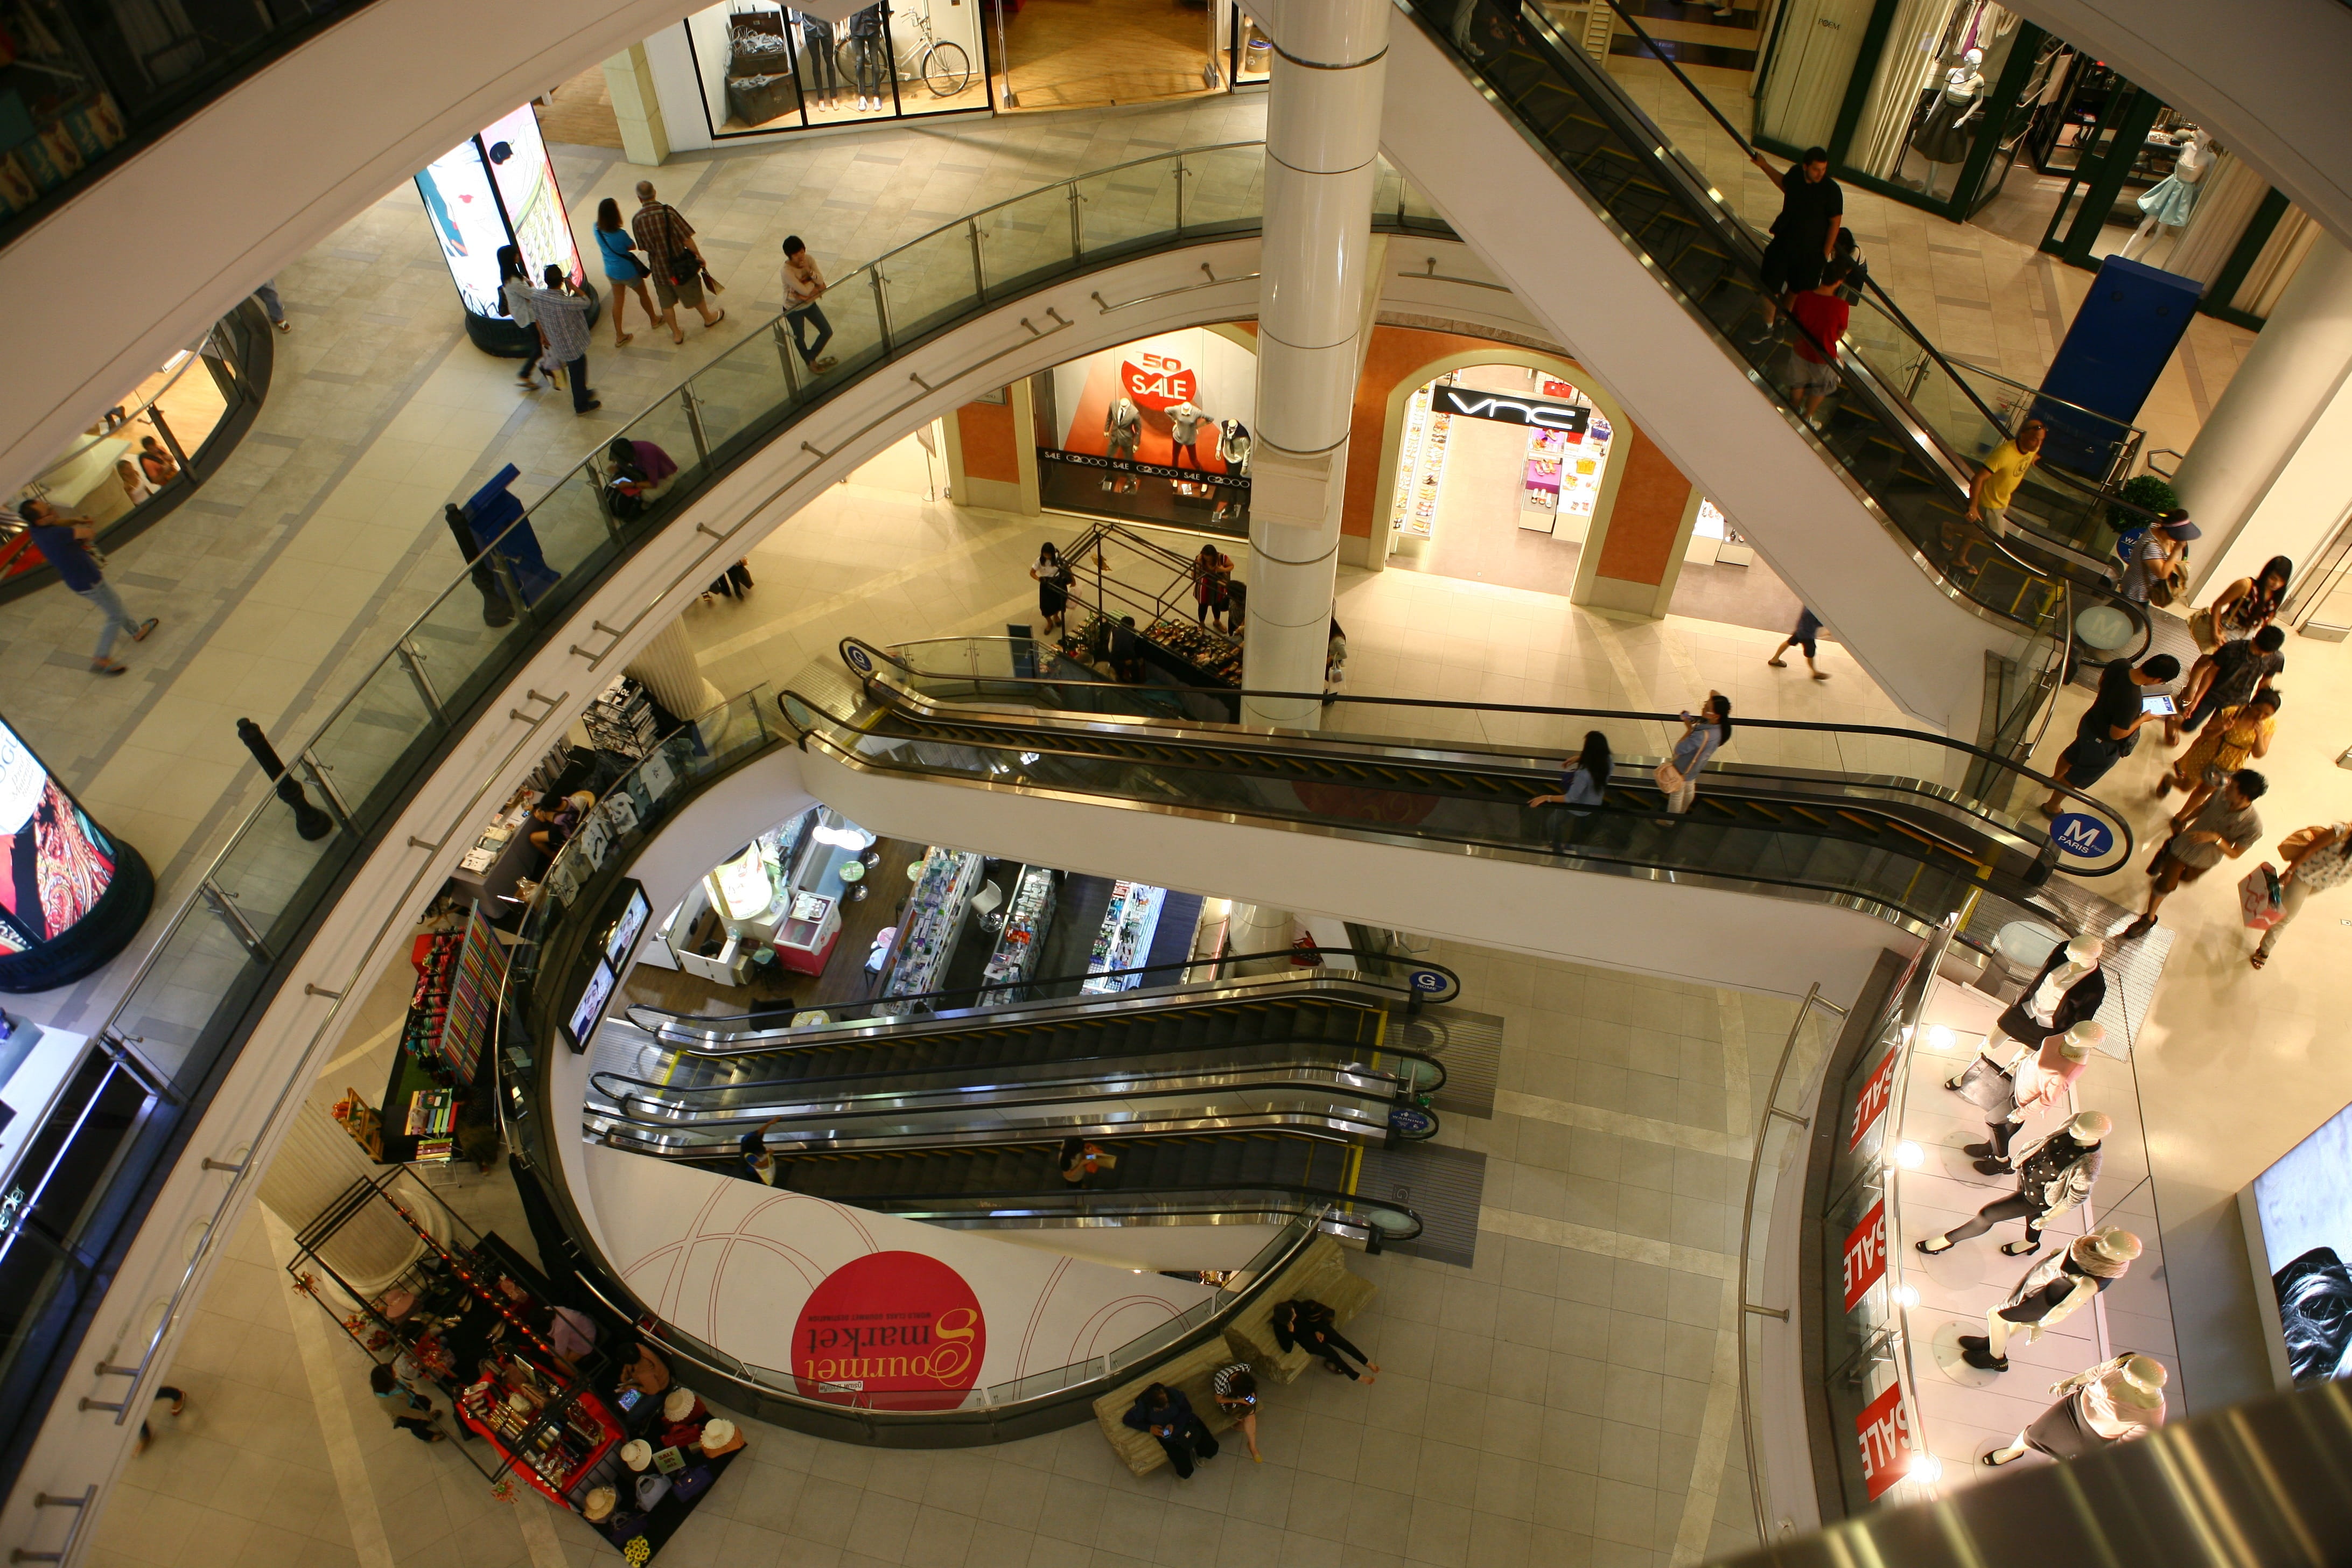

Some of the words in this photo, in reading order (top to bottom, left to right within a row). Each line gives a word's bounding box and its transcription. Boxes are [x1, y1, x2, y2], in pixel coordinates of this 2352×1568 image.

[1818, 18, 1840, 30] POEM
[1132, 374, 1187, 401] SALE
[1045, 451, 1061, 460] SALE
[1113, 461, 1129, 470] SALE
[1184, 472, 1200, 481] SALE
[2063, 819, 2101, 846] M
[2058, 835, 2090, 854] PARIS
[2091, 844, 2106, 854] Floor
[1417, 983, 1437, 991] ROME
[1418, 974, 1436, 986] G
[1851, 1057, 1894, 1138] SALE
[1392, 1115, 1425, 1125] WARNING
[1844, 1214, 1886, 1296] SALE
[808, 1313, 850, 1322] DESTINATION
[851, 1313, 883, 1321] GOURMET
[886, 1312, 906, 1320] CLASS
[908, 1312, 931, 1320] WORLD
[807, 1325, 930, 1357] market
[1859, 1398, 1910, 1480] SALE
